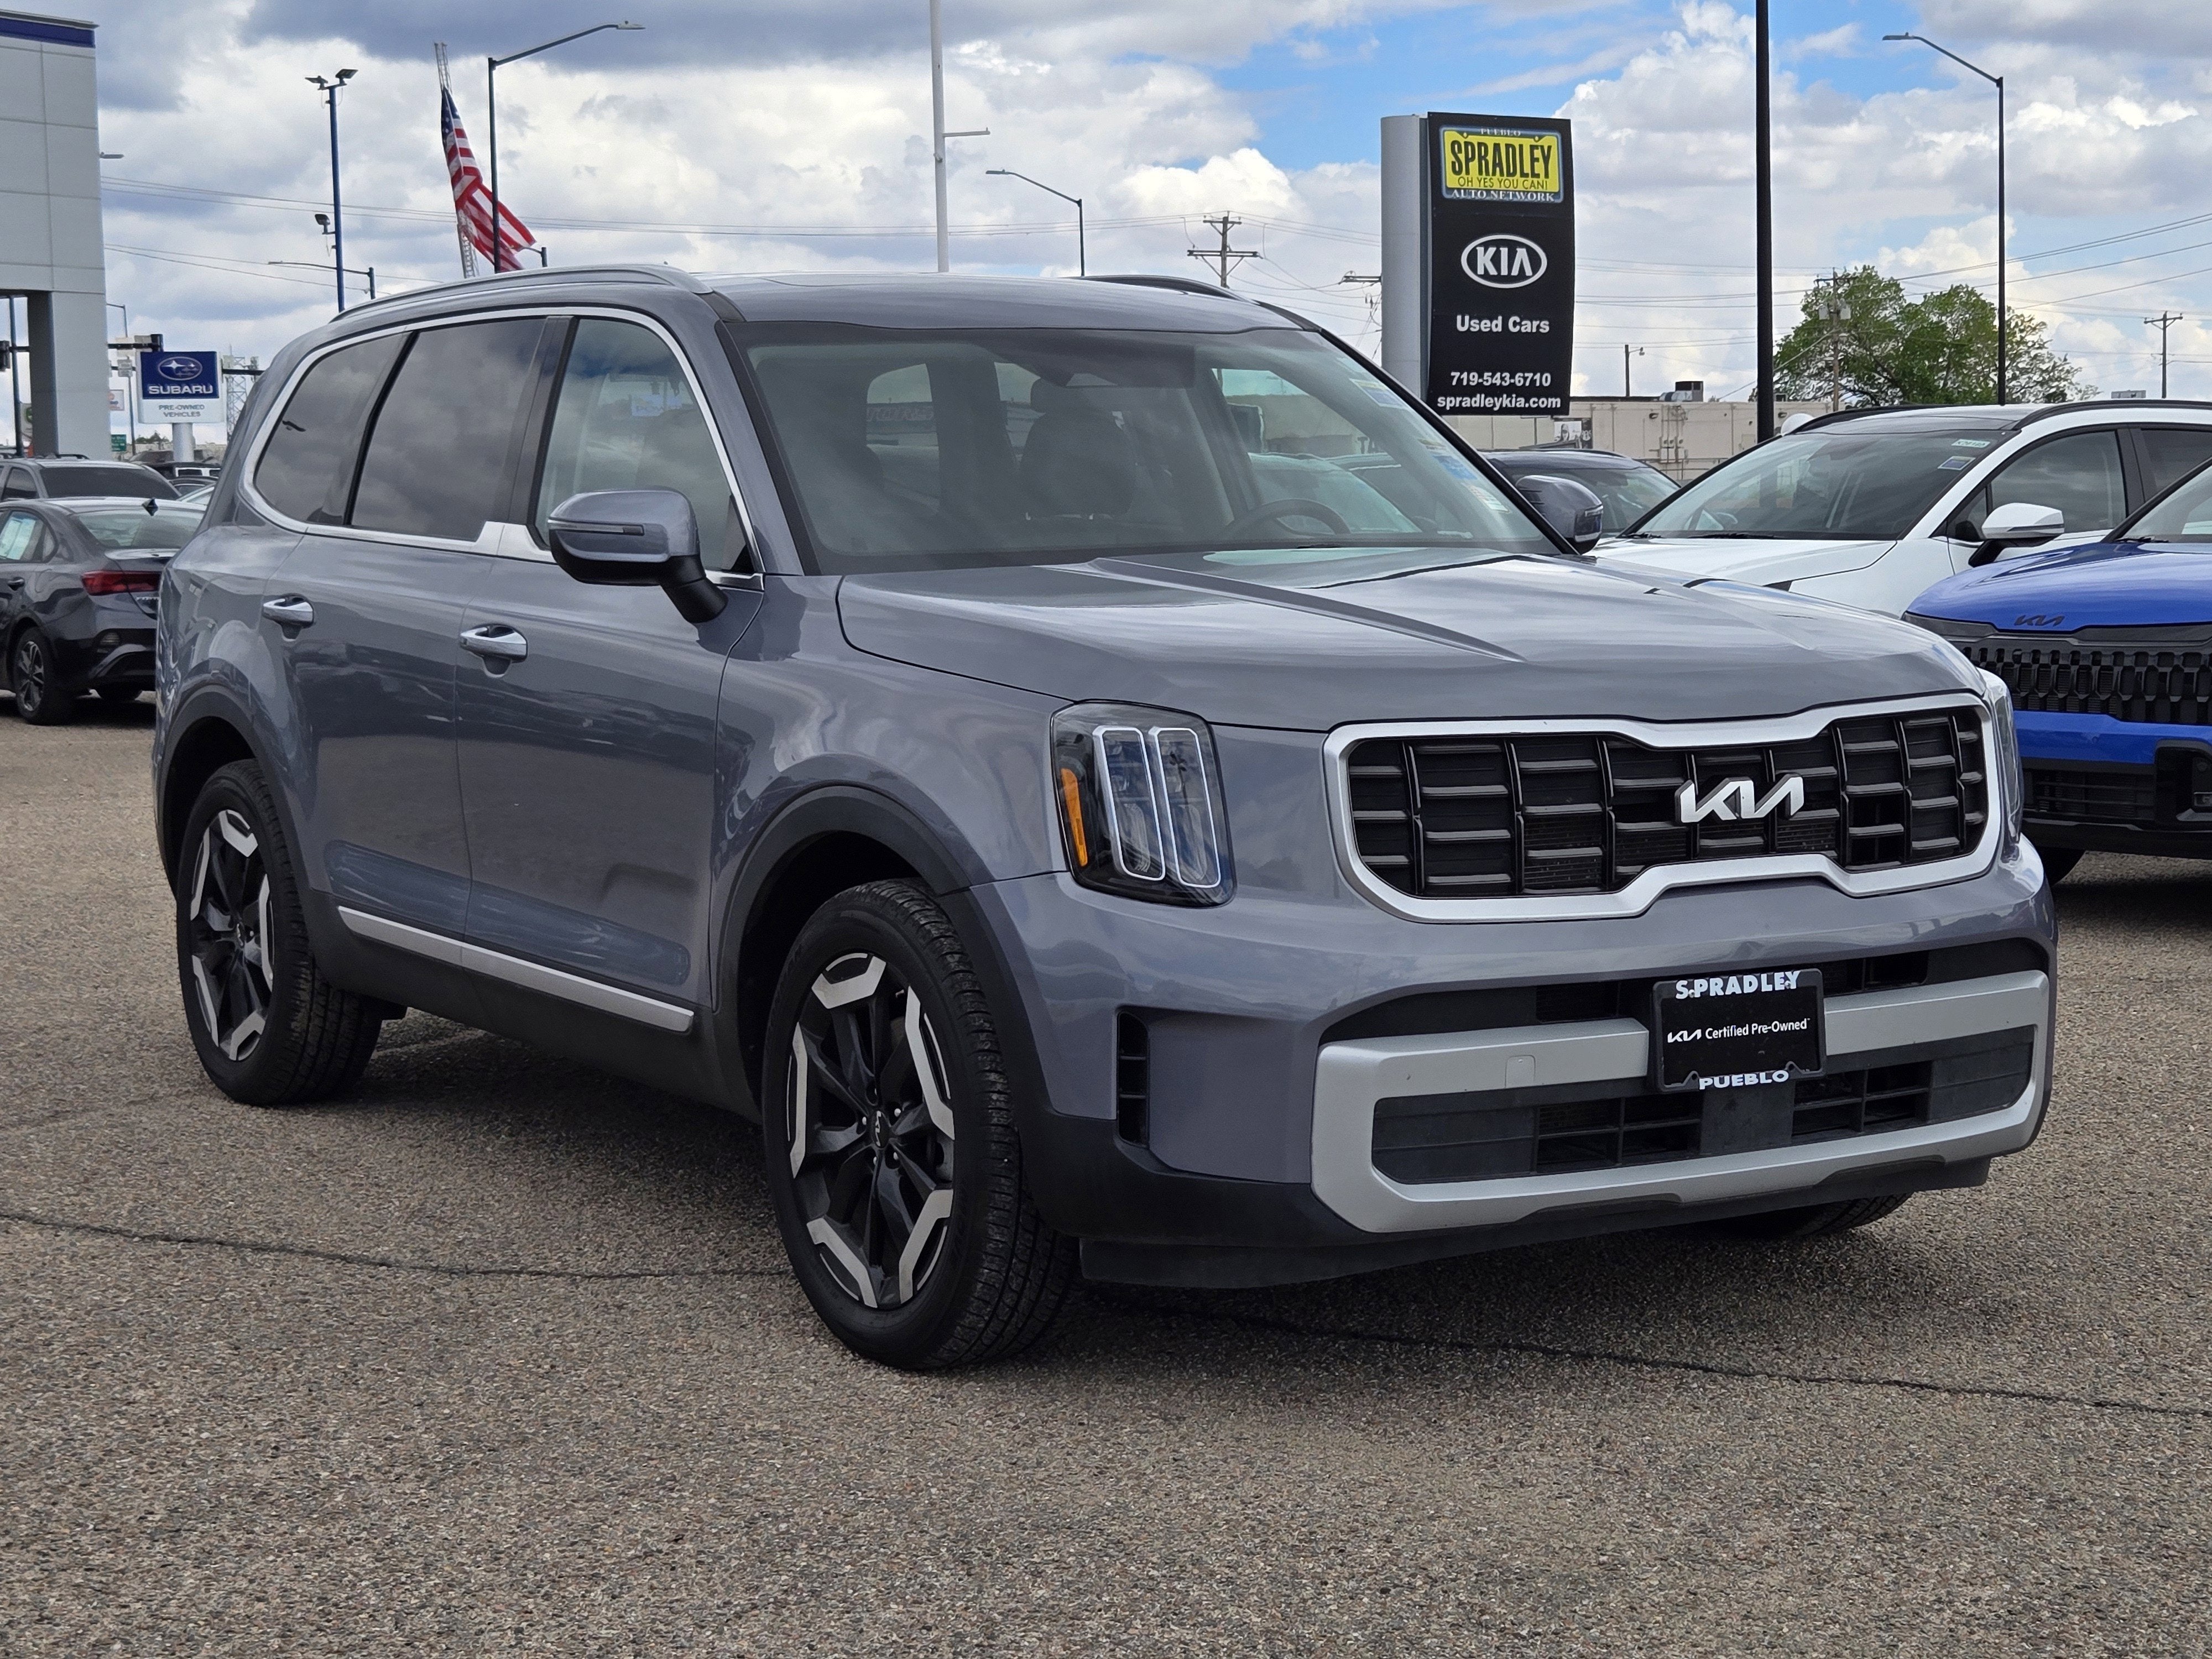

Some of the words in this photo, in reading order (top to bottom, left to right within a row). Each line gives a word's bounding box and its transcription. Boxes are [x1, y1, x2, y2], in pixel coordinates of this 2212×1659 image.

[1480, 128, 1521, 137] PUEBLO
[1450, 139, 1552, 179] SPRADLEY
[1458, 176, 1473, 187] OH
[1477, 177, 1494, 188] YES
[1497, 178, 1519, 189] YOU
[1451, 189, 1486, 199] AUTO
[1490, 191, 1554, 202] NETWORK
[1476, 247, 1533, 276] KIA
[1457, 315, 1503, 332] Used
[1508, 316, 1550, 333] Cars
[1451, 372, 1551, 387] 719-543-6710
[149, 384, 213, 394] SUBARU
[1437, 393, 1561, 411] spradleykia.com
[1676, 774, 1804, 823] KIA
[1676, 971, 1801, 999] SPRADLEY
[1667, 1029, 1702, 1044] KIA
[1705, 1024, 1749, 1040] Certified
[1751, 1018, 1808, 1035] Pre-Owned
[1699, 1070, 1790, 1090] PUEBLO
